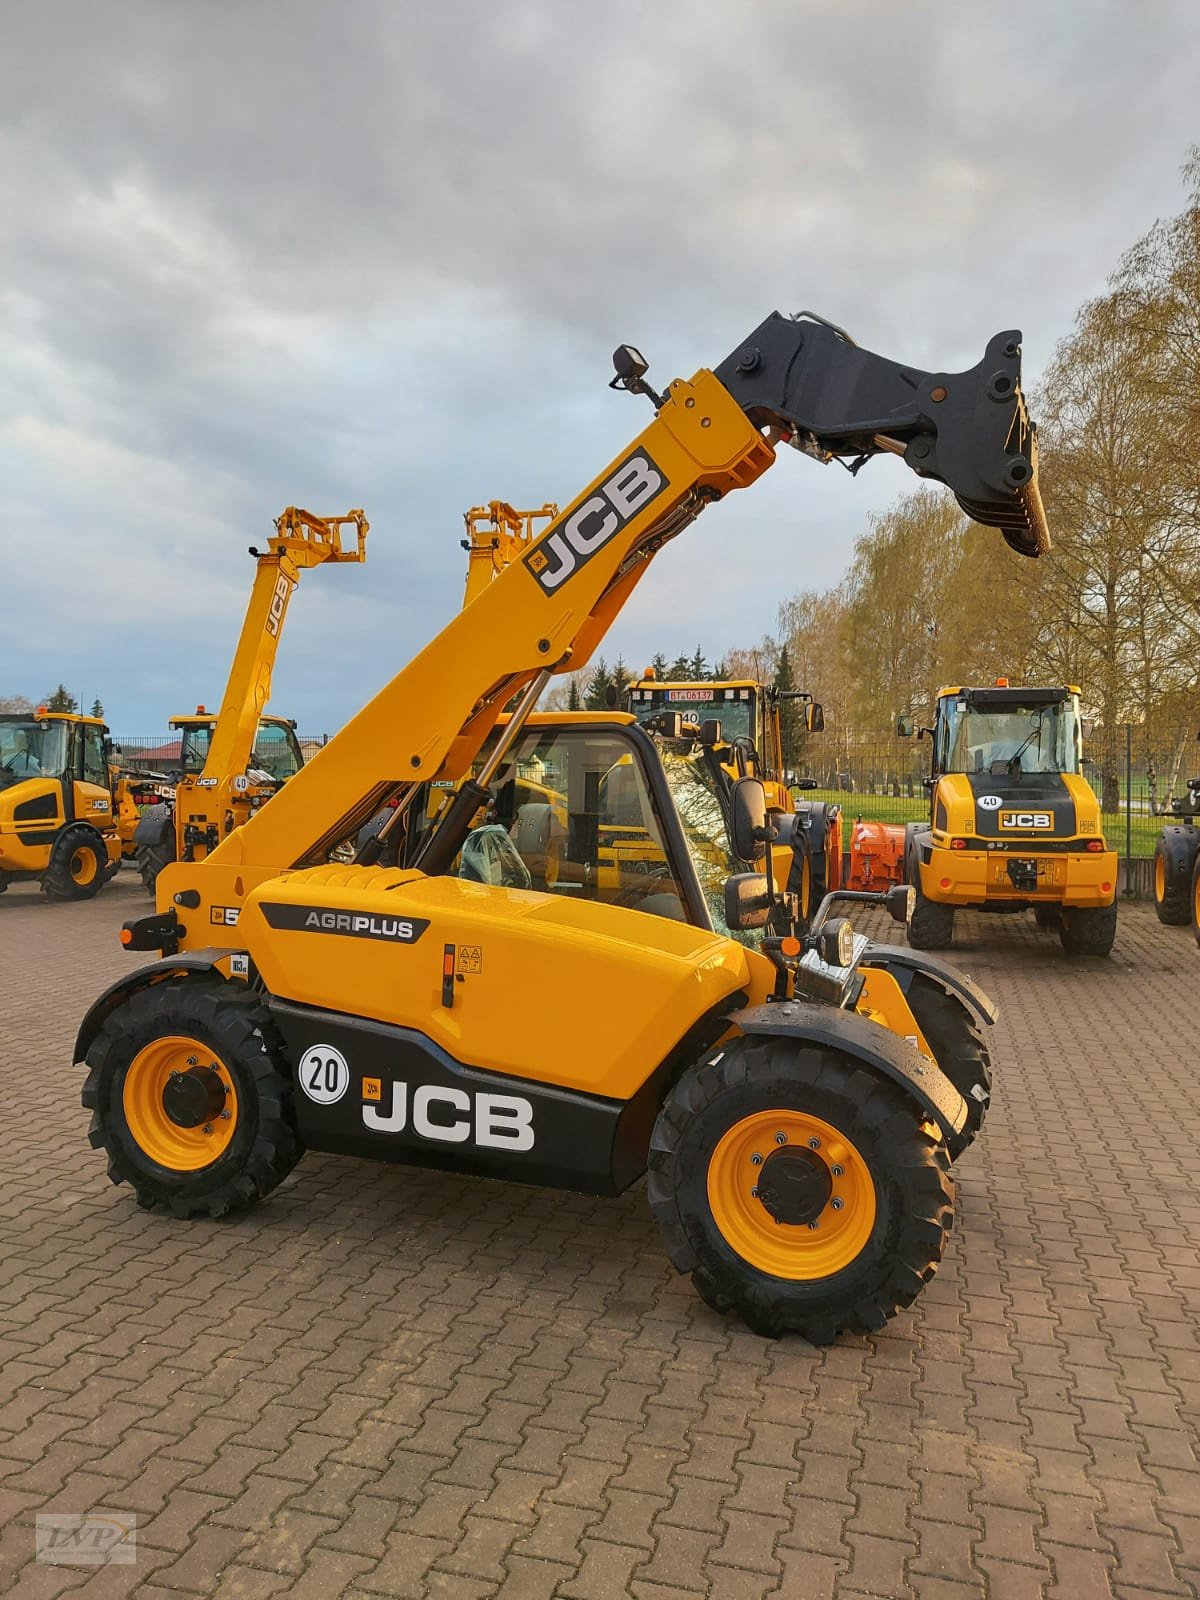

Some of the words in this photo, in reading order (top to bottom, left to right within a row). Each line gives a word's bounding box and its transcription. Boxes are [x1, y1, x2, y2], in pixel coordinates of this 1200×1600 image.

[540, 457, 661, 588] JCB
[269, 575, 289, 637] JCB
[682, 713, 698, 724] 40
[236, 778, 247, 789] 40
[92, 800, 109, 809] JCB
[983, 797, 997, 806] 40
[1003, 814, 1050, 827] JCB
[305, 911, 413, 938] AGRIPLUS
[308, 1056, 339, 1093] 20
[362, 1080, 535, 1152] JCB
